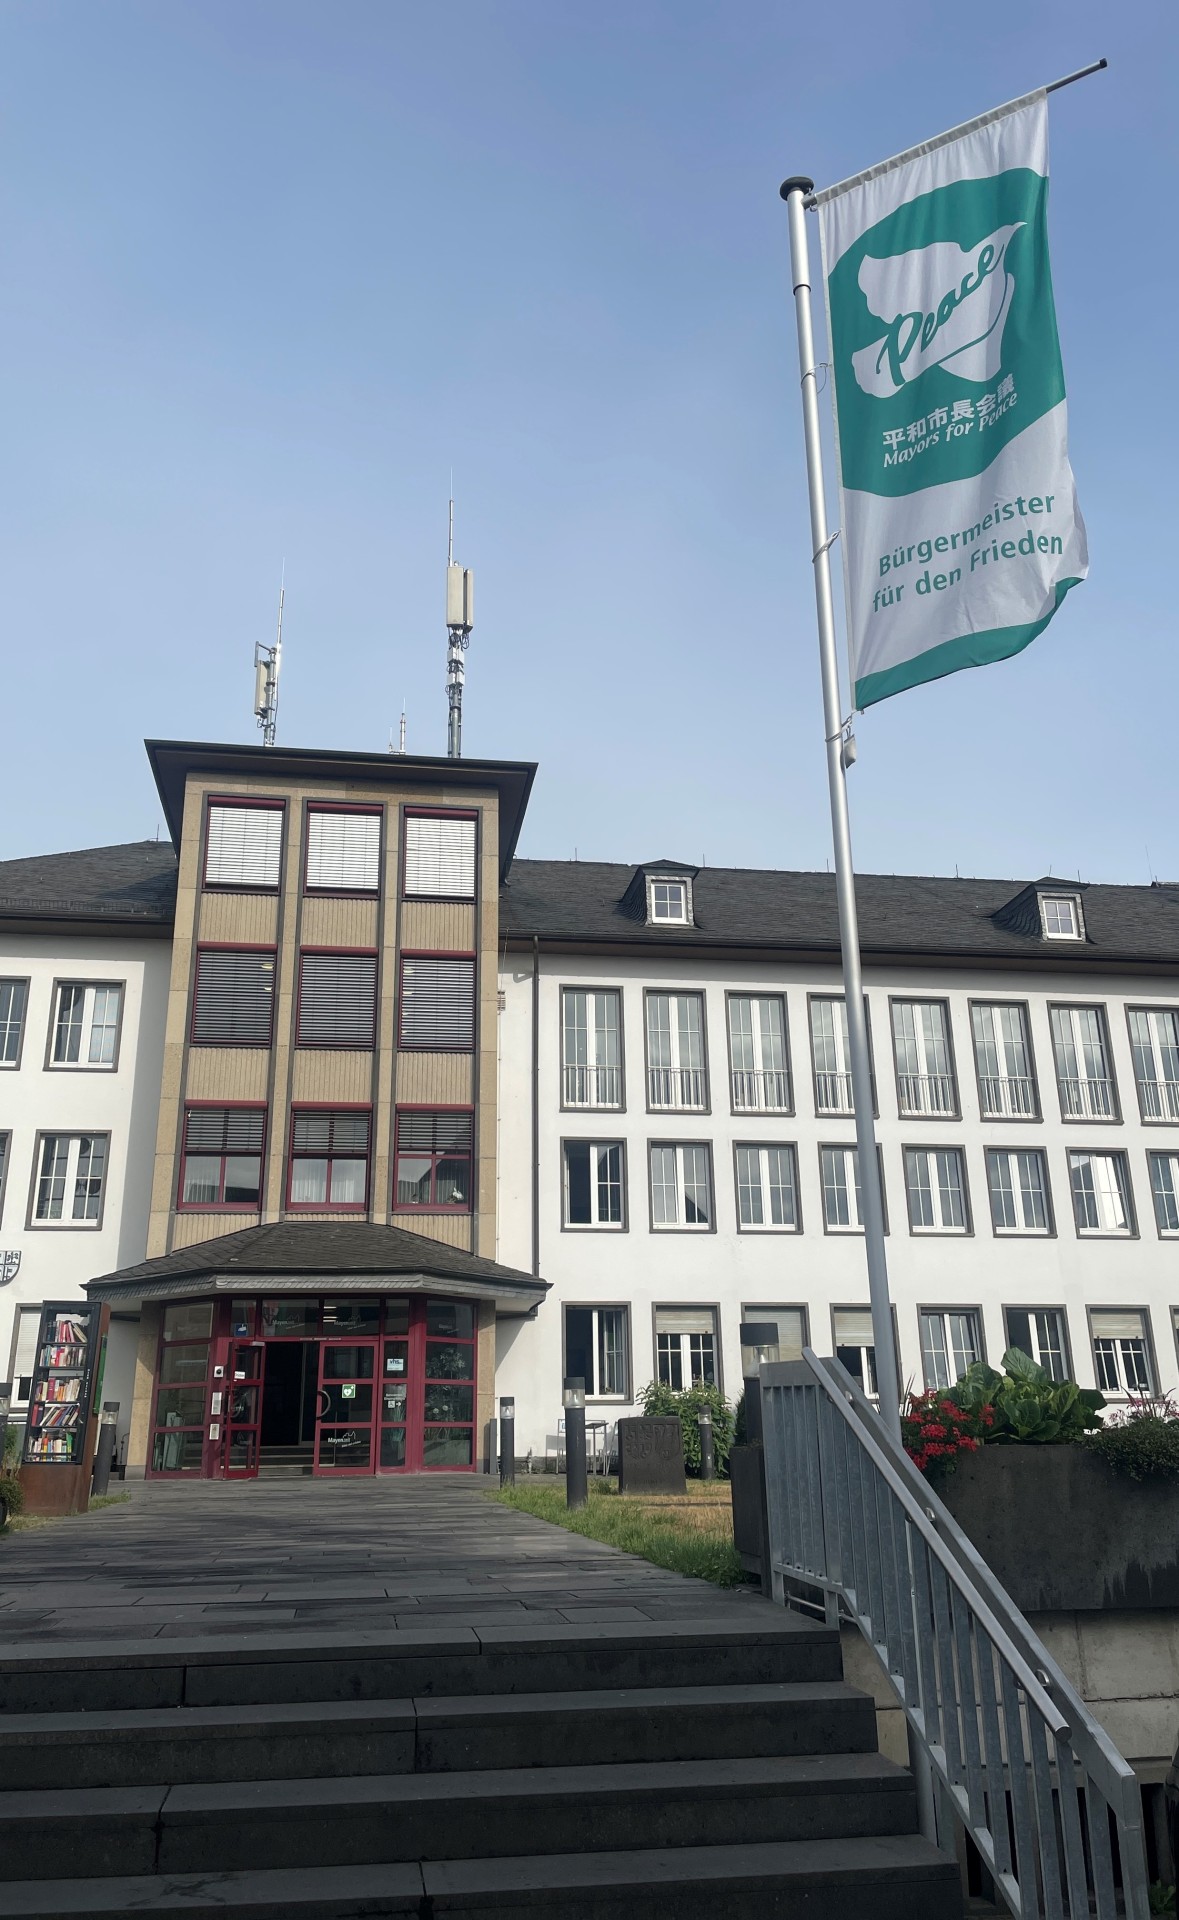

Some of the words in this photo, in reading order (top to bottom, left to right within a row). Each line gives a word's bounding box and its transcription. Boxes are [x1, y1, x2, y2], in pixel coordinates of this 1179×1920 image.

[876, 244, 1005, 387] Peace
[882, 373, 1015, 450] 平和市長会議
[883, 431, 940, 468] Mayors
[945, 421, 975, 441] for
[978, 392, 1018, 432] Peace
[872, 584, 905, 613] für
[915, 571, 961, 596] den
[970, 529, 1063, 572] Frieden
[879, 495, 1055, 577] Bürgermeister
